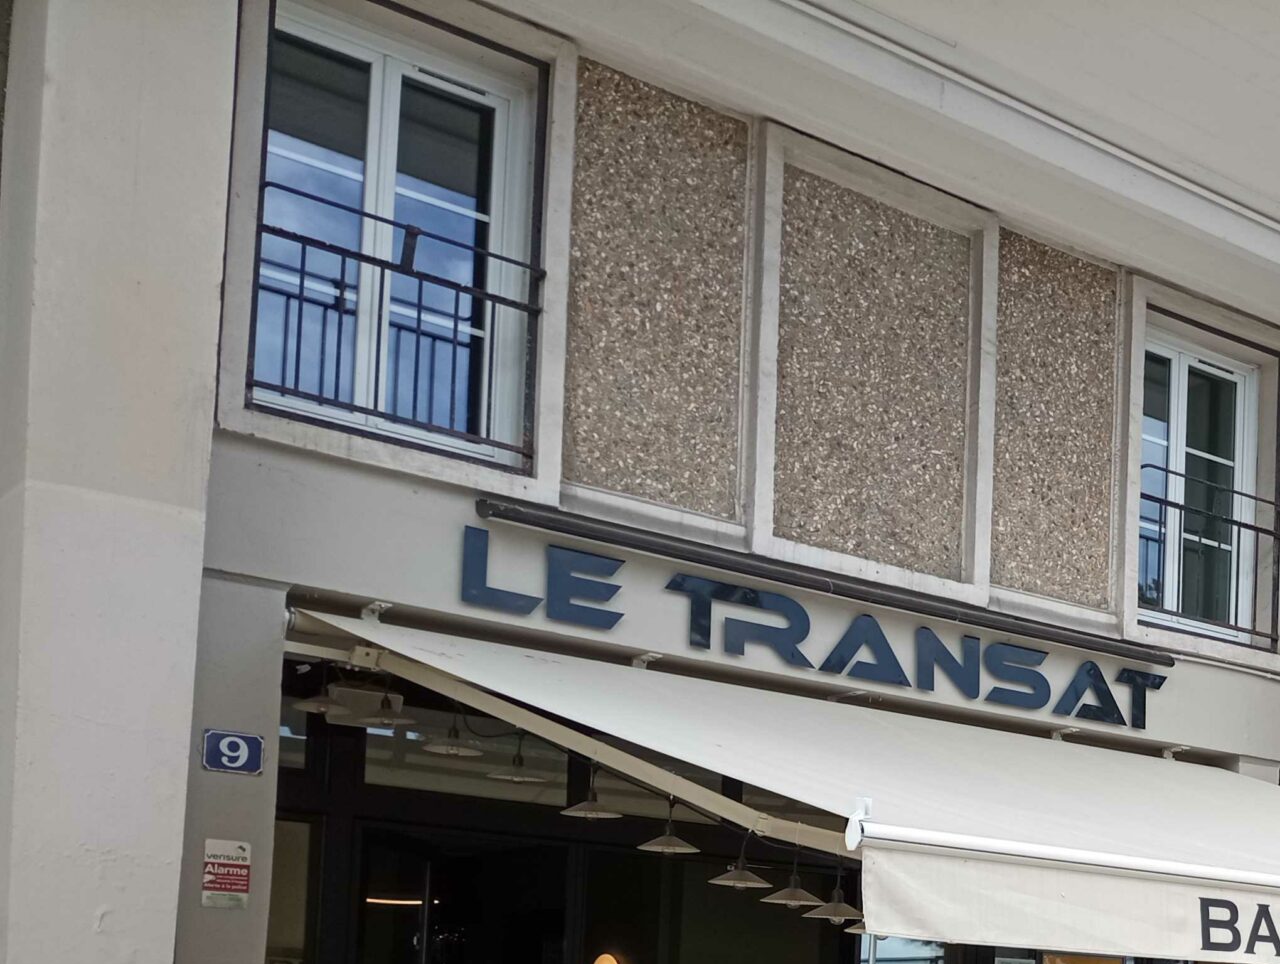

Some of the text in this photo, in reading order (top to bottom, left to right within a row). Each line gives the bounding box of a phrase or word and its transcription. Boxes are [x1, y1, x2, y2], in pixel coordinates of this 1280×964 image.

[461, 525, 1168, 730] LE TRANSAT
[219, 736, 249, 768] 9
[206, 853, 248, 862] verisure
[204, 863, 248, 875] Alarme
